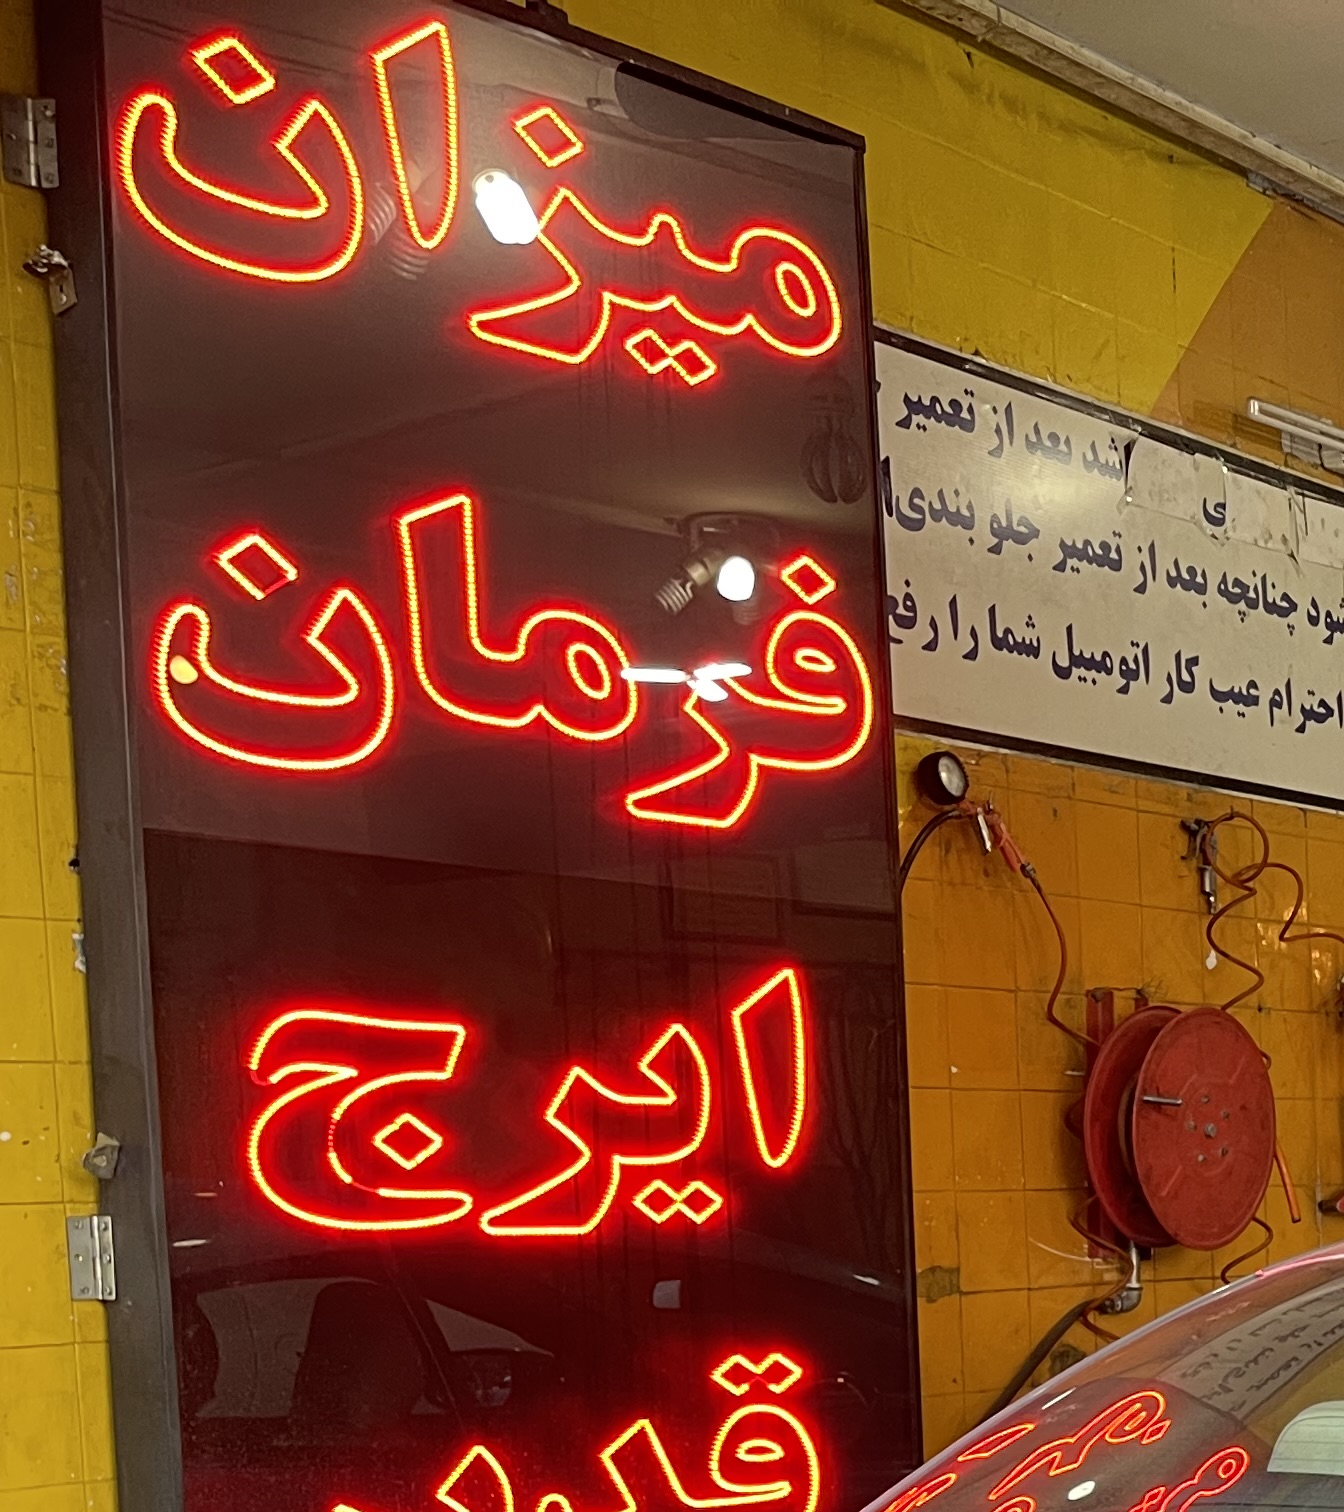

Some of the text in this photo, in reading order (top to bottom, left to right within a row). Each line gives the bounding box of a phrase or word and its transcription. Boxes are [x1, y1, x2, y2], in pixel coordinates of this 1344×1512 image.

[119, 22, 842, 386] میزان
[895, 387, 976, 433] تعمیر
[987, 400, 1014, 458] از
[895, 487, 976, 546] بندی
[987, 498, 1040, 563] جلو
[1052, 530, 1123, 573] تعمیر
[1133, 540, 1156, 595] از
[1166, 557, 1207, 609] بعد
[1217, 570, 1298, 637] چنانچه
[949, 594, 980, 661] را
[988, 603, 1041, 660] شما
[159, 494, 875, 827] فرمان
[1052, 623, 1150, 695] اتومبیل
[1160, 649, 1199, 704] کار
[1209, 679, 1260, 719] عیب
[1269, 677, 1344, 734] احترام
[248, 967, 804, 1236] ایرج
